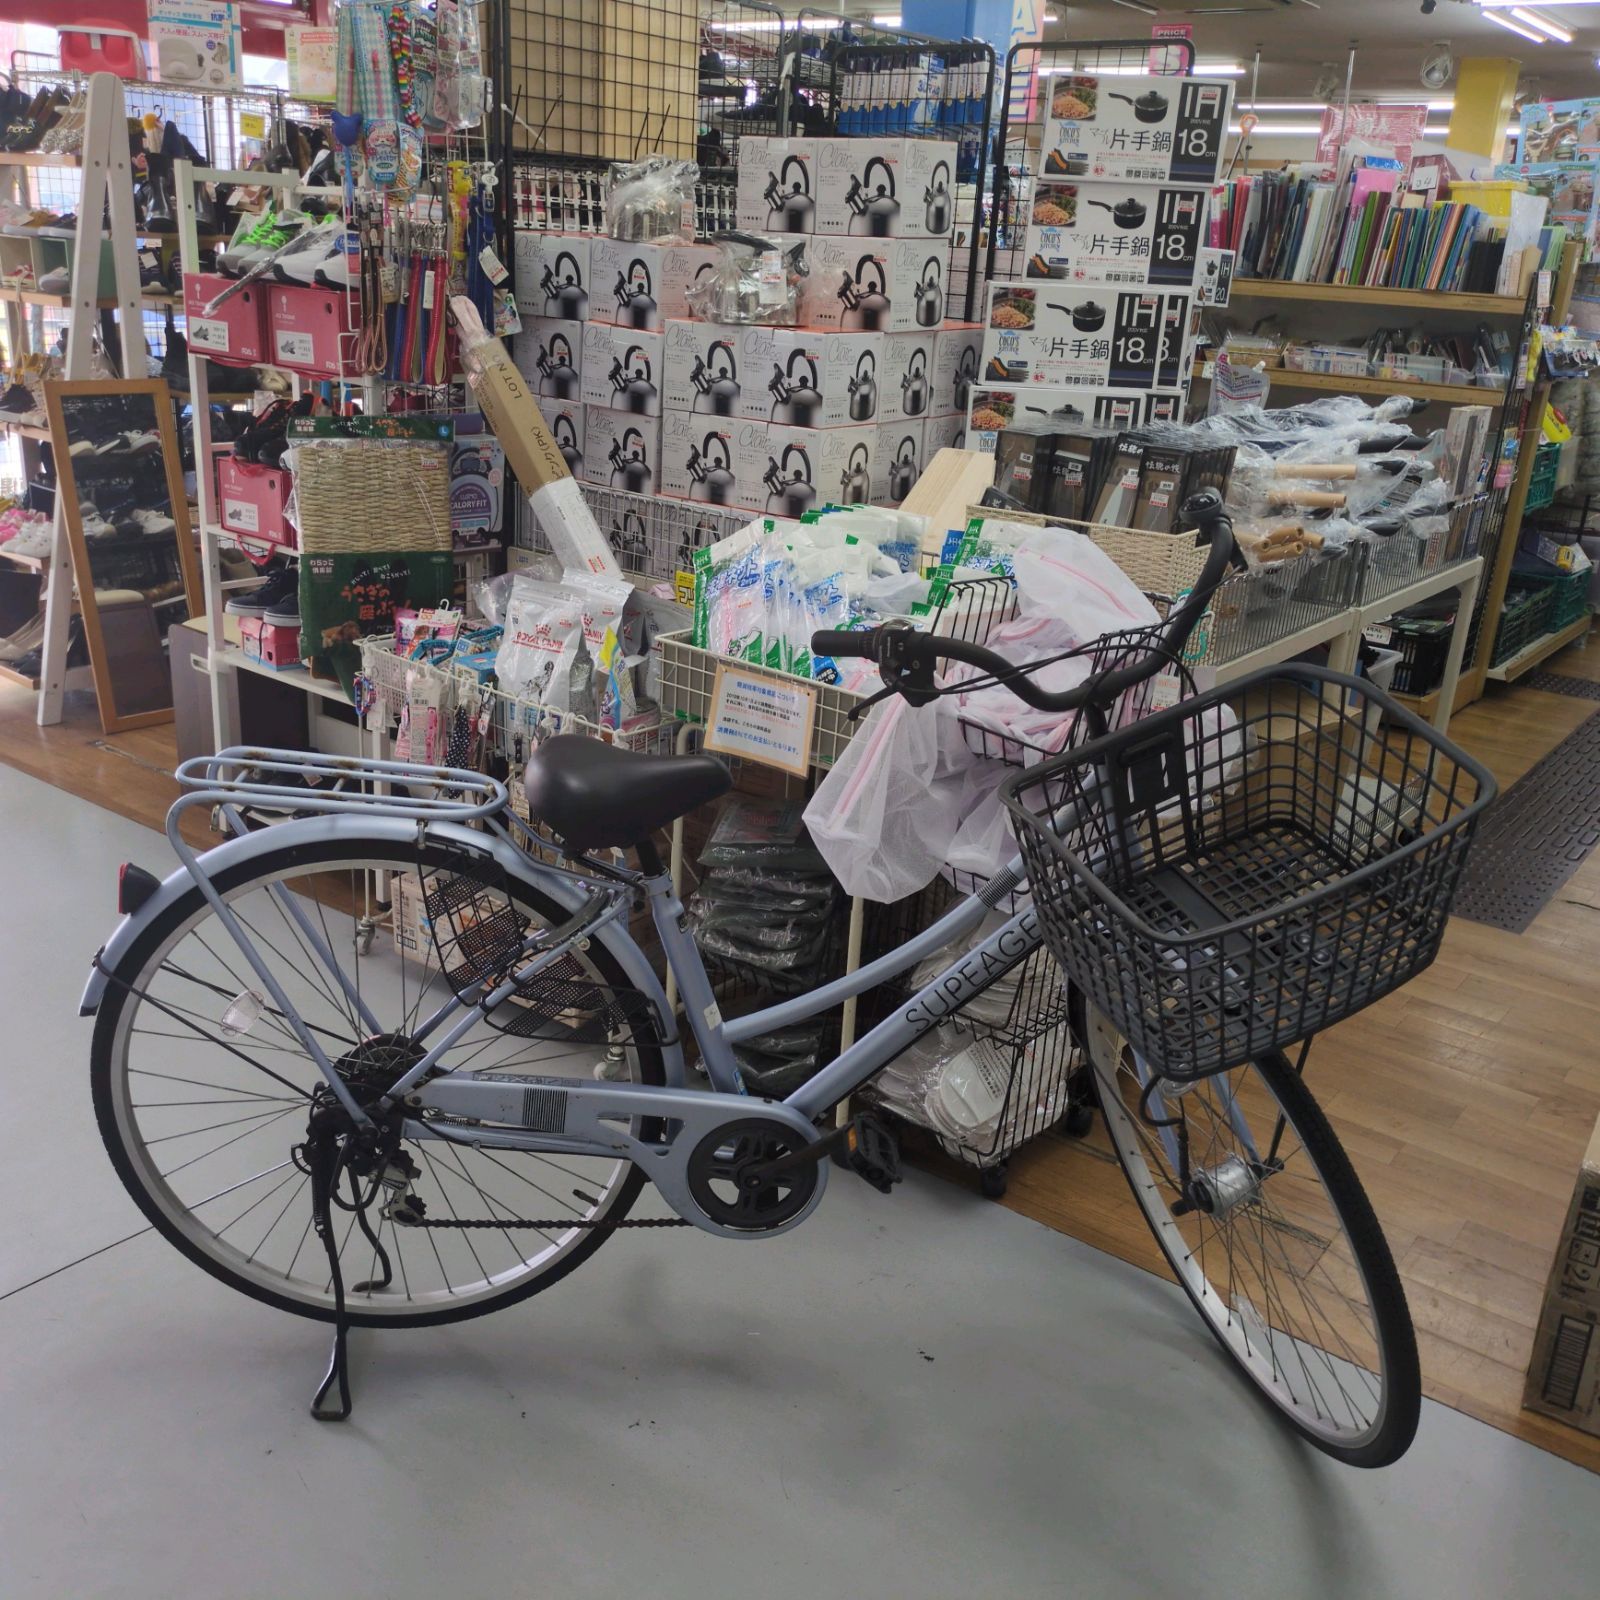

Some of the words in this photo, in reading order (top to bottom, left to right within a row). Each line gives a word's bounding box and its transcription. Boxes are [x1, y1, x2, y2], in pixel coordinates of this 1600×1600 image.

[1184, 85, 1222, 119] IH
[1109, 128, 1172, 153] 片手鍋
[1162, 192, 1198, 225] IH
[1089, 234, 1150, 257] 片手鍋
[1121, 295, 1157, 327] IH
[1049, 336, 1110, 360] 片手鍋
[502, 373, 522, 400] LOT
[476, 499, 488, 507] FIT
[516, 631, 540, 645] ROYAL
